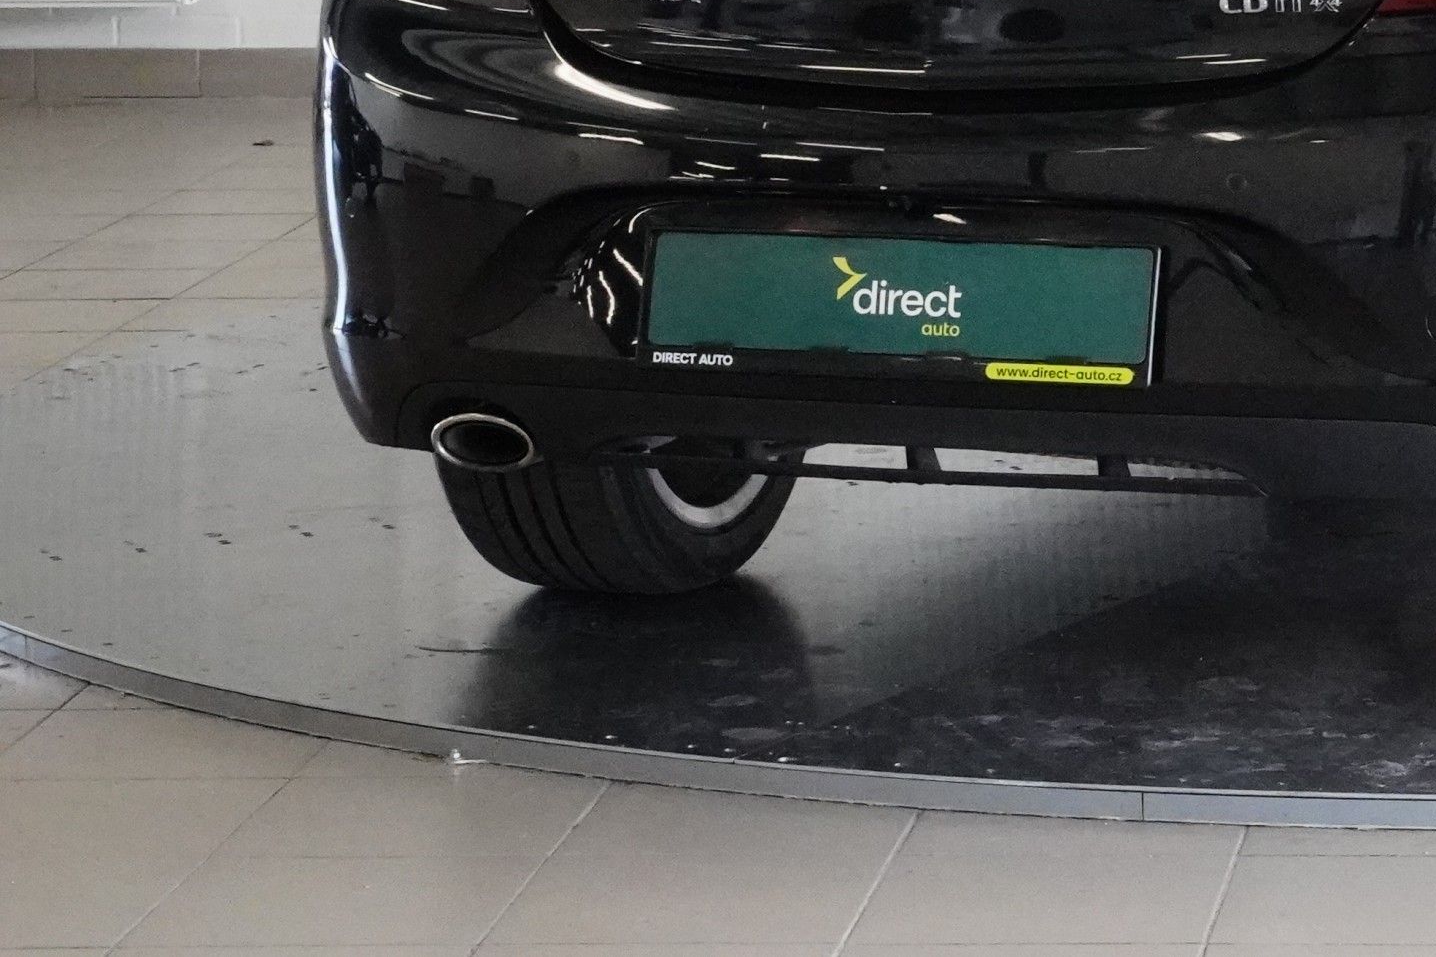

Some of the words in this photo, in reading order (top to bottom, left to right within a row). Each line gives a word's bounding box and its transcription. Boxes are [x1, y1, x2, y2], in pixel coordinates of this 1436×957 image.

[852, 279, 962, 318] direct
[921, 323, 960, 337] auto
[652, 351, 698, 365] DIRECT
[698, 353, 734, 366] AUTO
[996, 366, 1122, 382] www.direct-auto.cz
